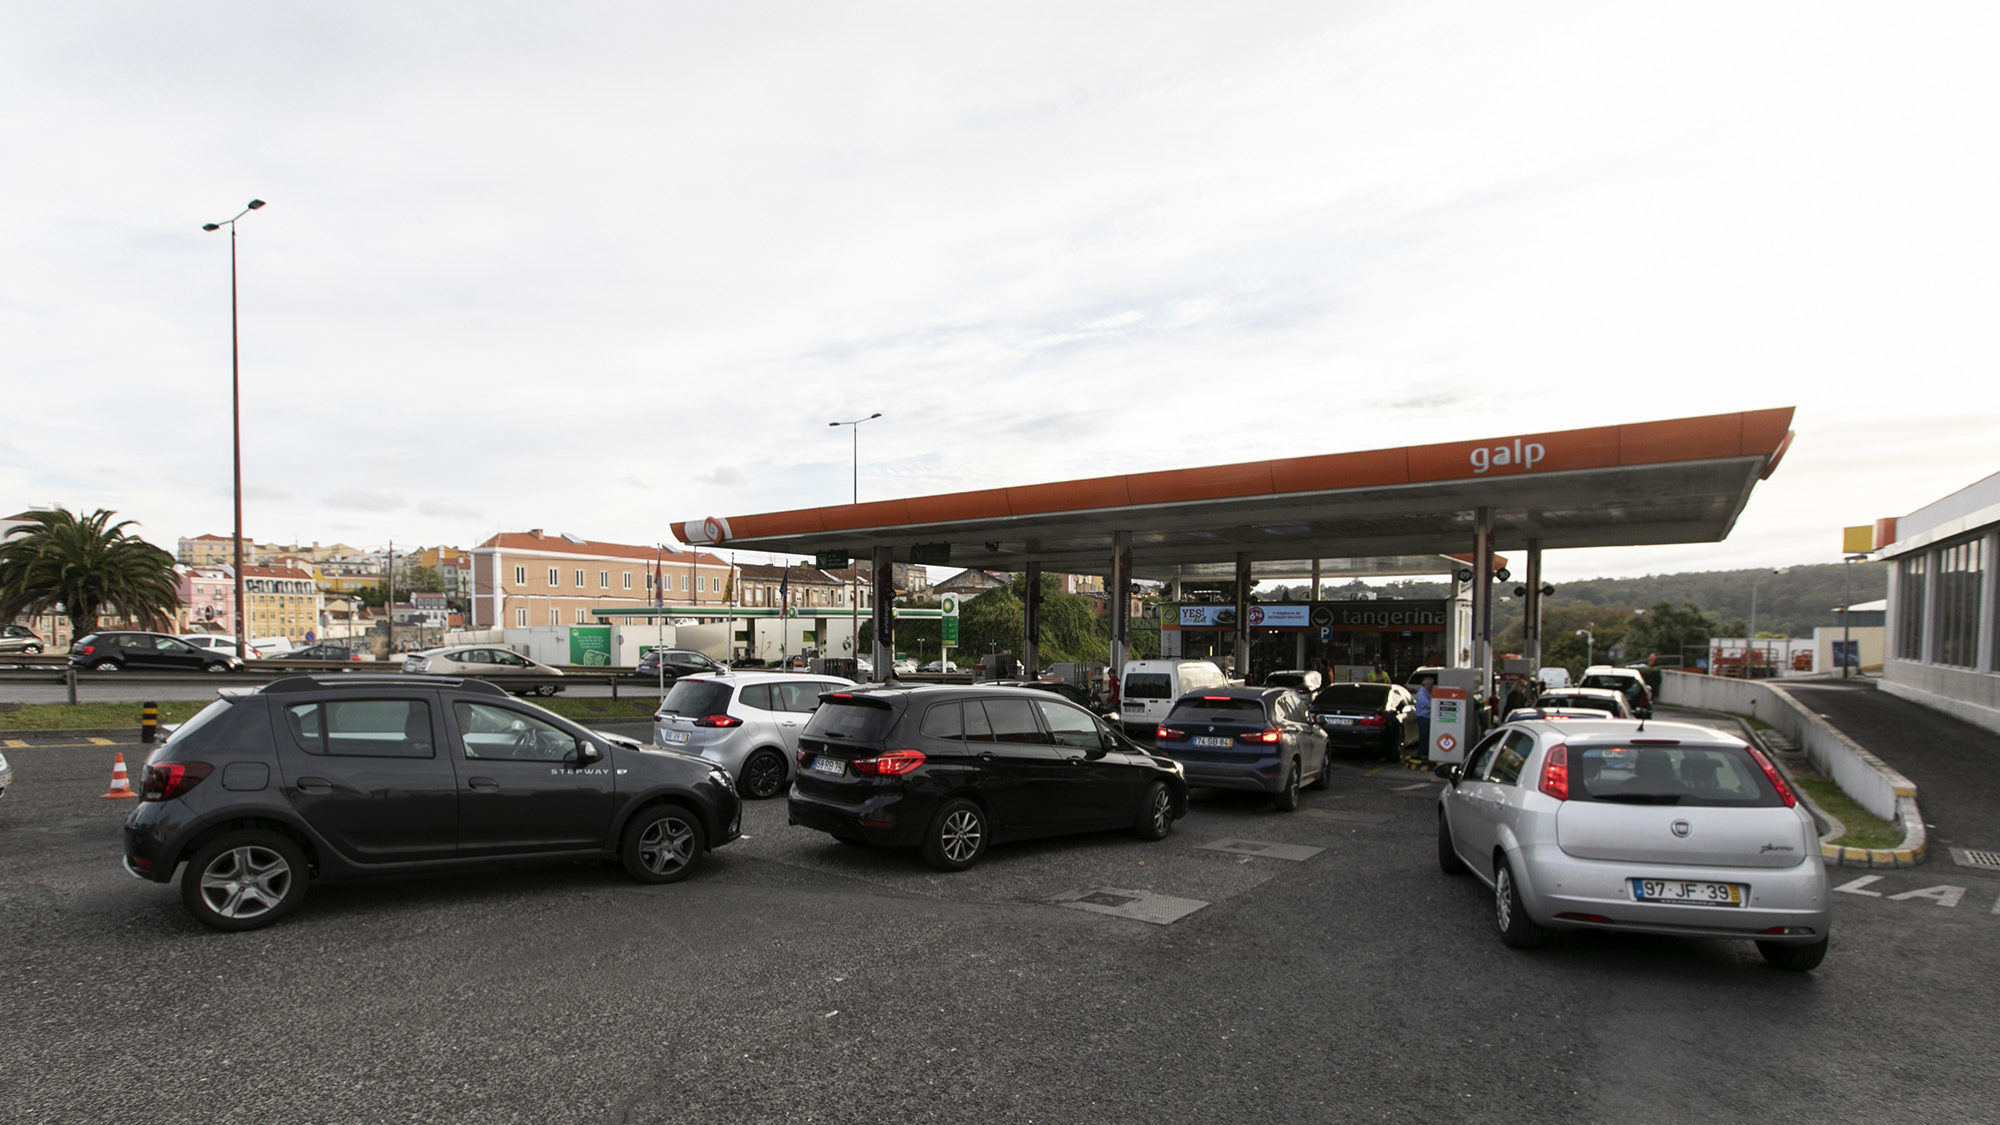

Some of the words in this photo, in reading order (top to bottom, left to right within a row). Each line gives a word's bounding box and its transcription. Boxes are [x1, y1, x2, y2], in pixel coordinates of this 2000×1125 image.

[1470, 439, 1545, 473] galp
[1182, 607, 1205, 618] YES!
[1341, 607, 1446, 628] tangerina
[1321, 627, 1330, 638] P
